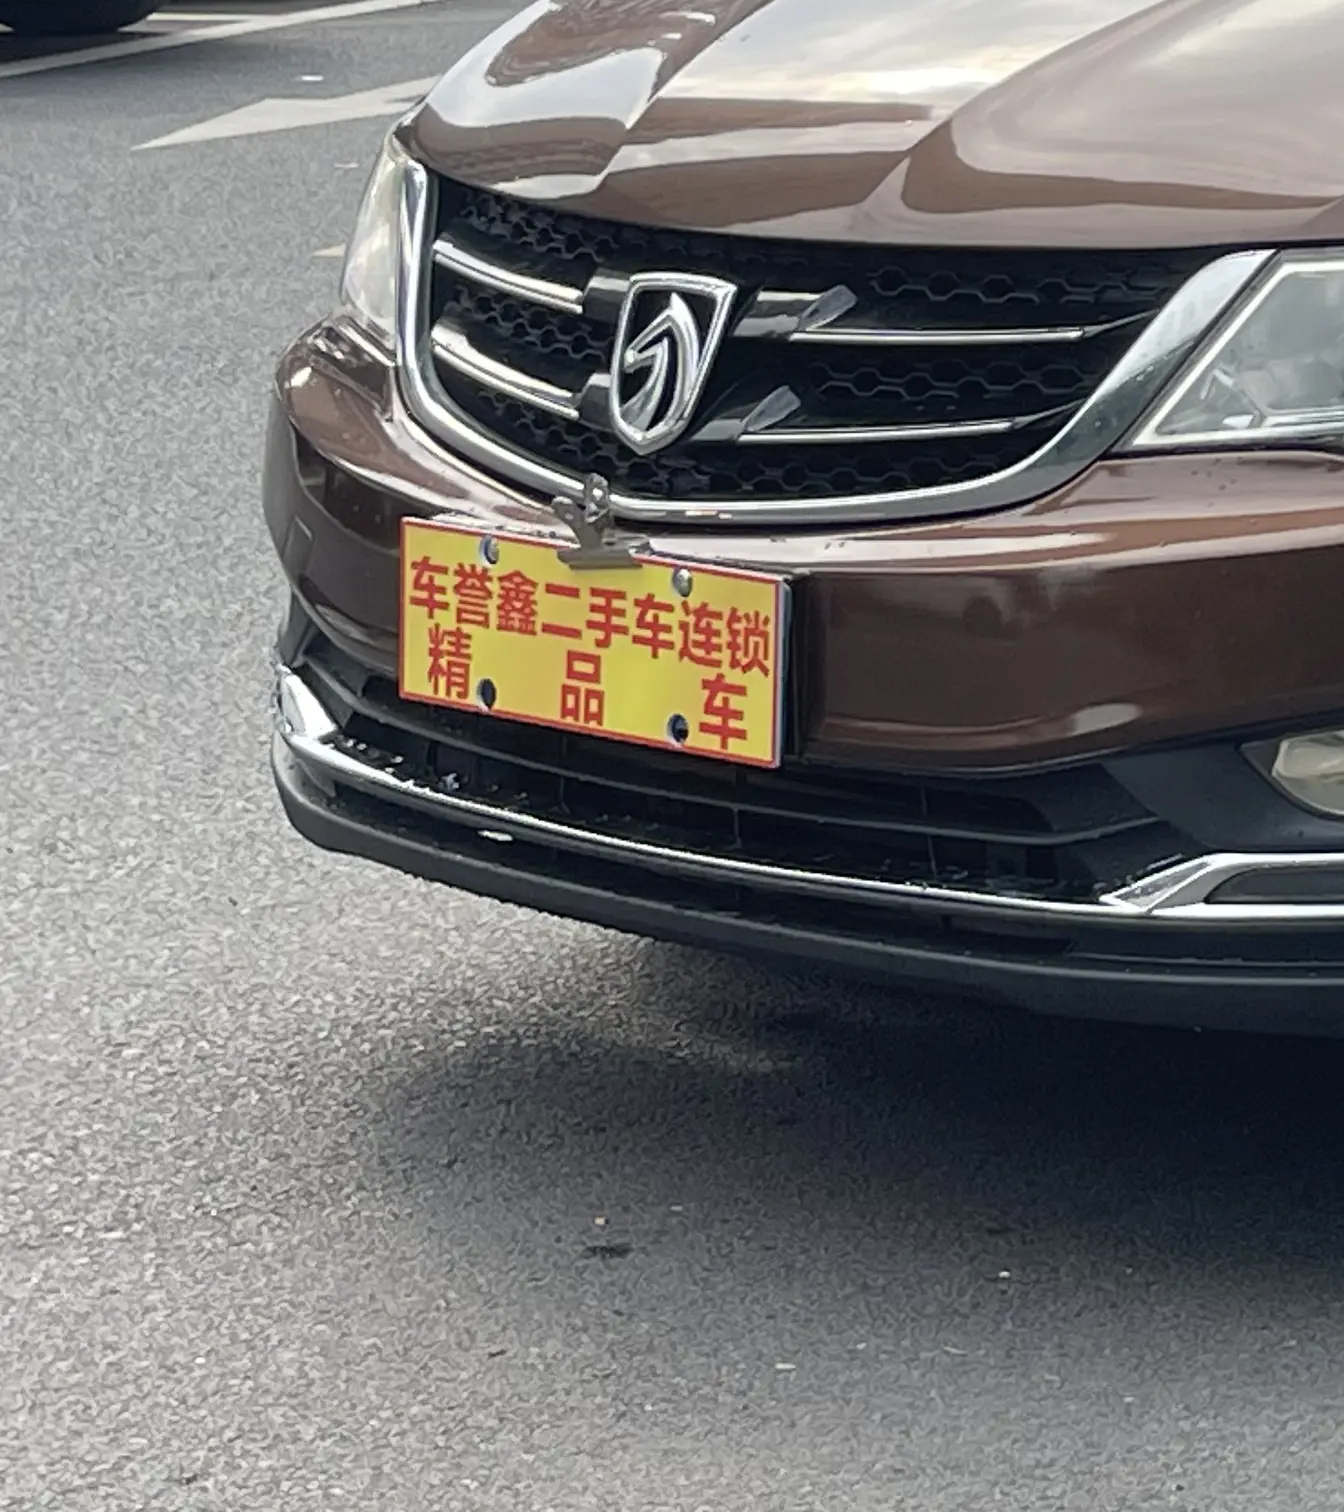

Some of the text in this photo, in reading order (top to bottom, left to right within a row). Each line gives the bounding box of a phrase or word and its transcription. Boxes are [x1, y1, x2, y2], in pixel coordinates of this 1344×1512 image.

[410, 556, 770, 677] 车誉鑫二手车连锁
